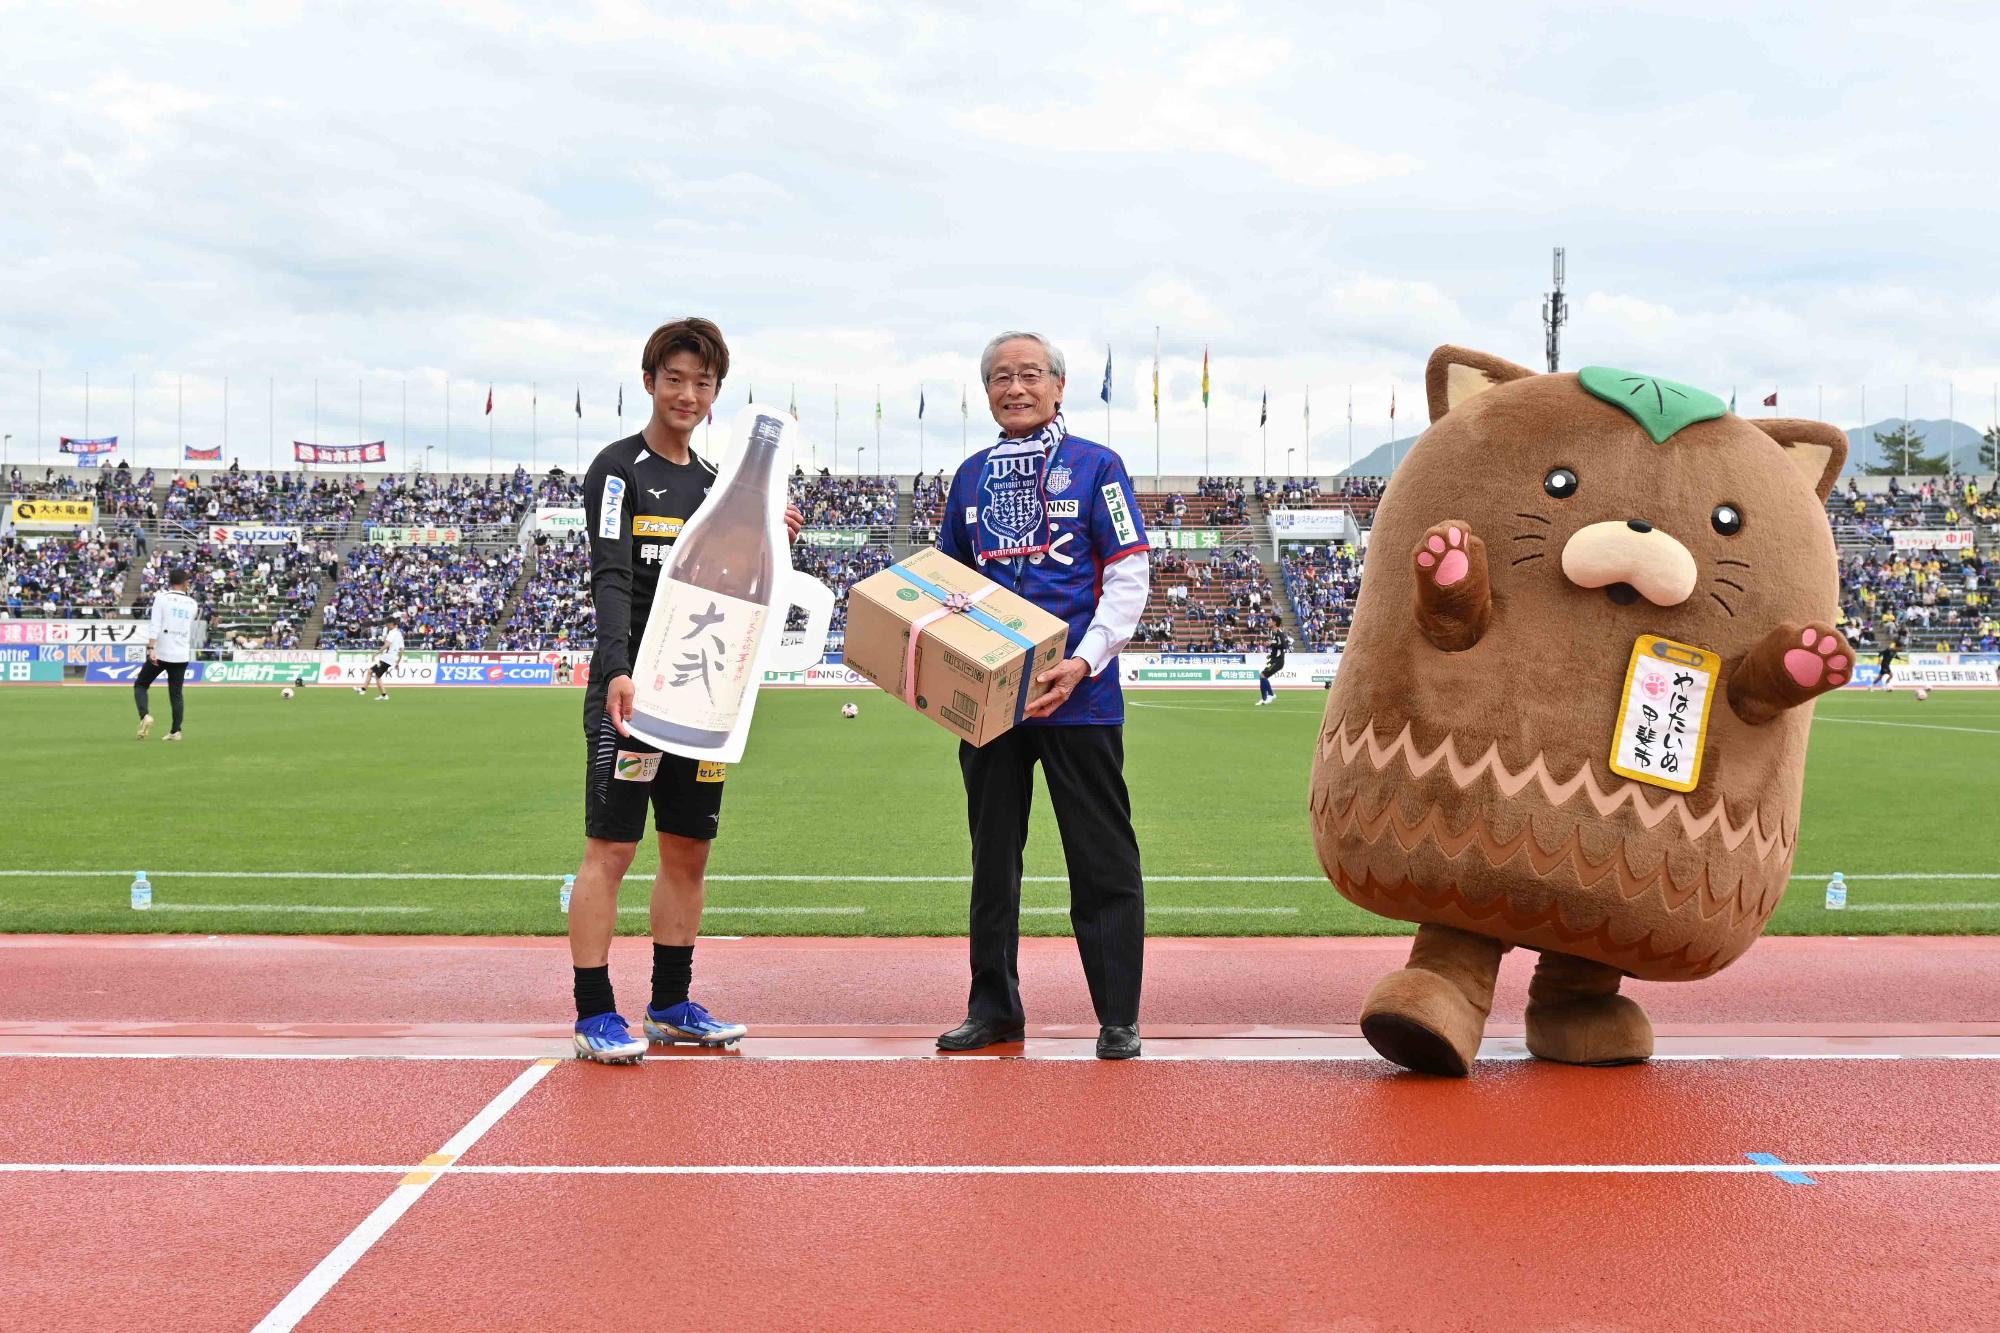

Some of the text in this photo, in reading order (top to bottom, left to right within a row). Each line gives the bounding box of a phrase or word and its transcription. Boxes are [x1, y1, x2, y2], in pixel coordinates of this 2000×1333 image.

[1047, 501, 1076, 513] NNS
[233, 530, 297, 541] SUZUK
[988, 546, 1026, 558] VENTFORET
[76, 624, 137, 642] オギノ
[66, 644, 120, 663] KKL
[347, 668, 431, 679] KYKUYO
[440, 666, 550, 680] YSK e-com
[817, 671, 843, 679] NNS
[1221, 671, 1255, 679] 明治安田
[1897, 670, 1993, 682] 山梨日日新聞社
[1660, 671, 1694, 773] やはたいぬ
